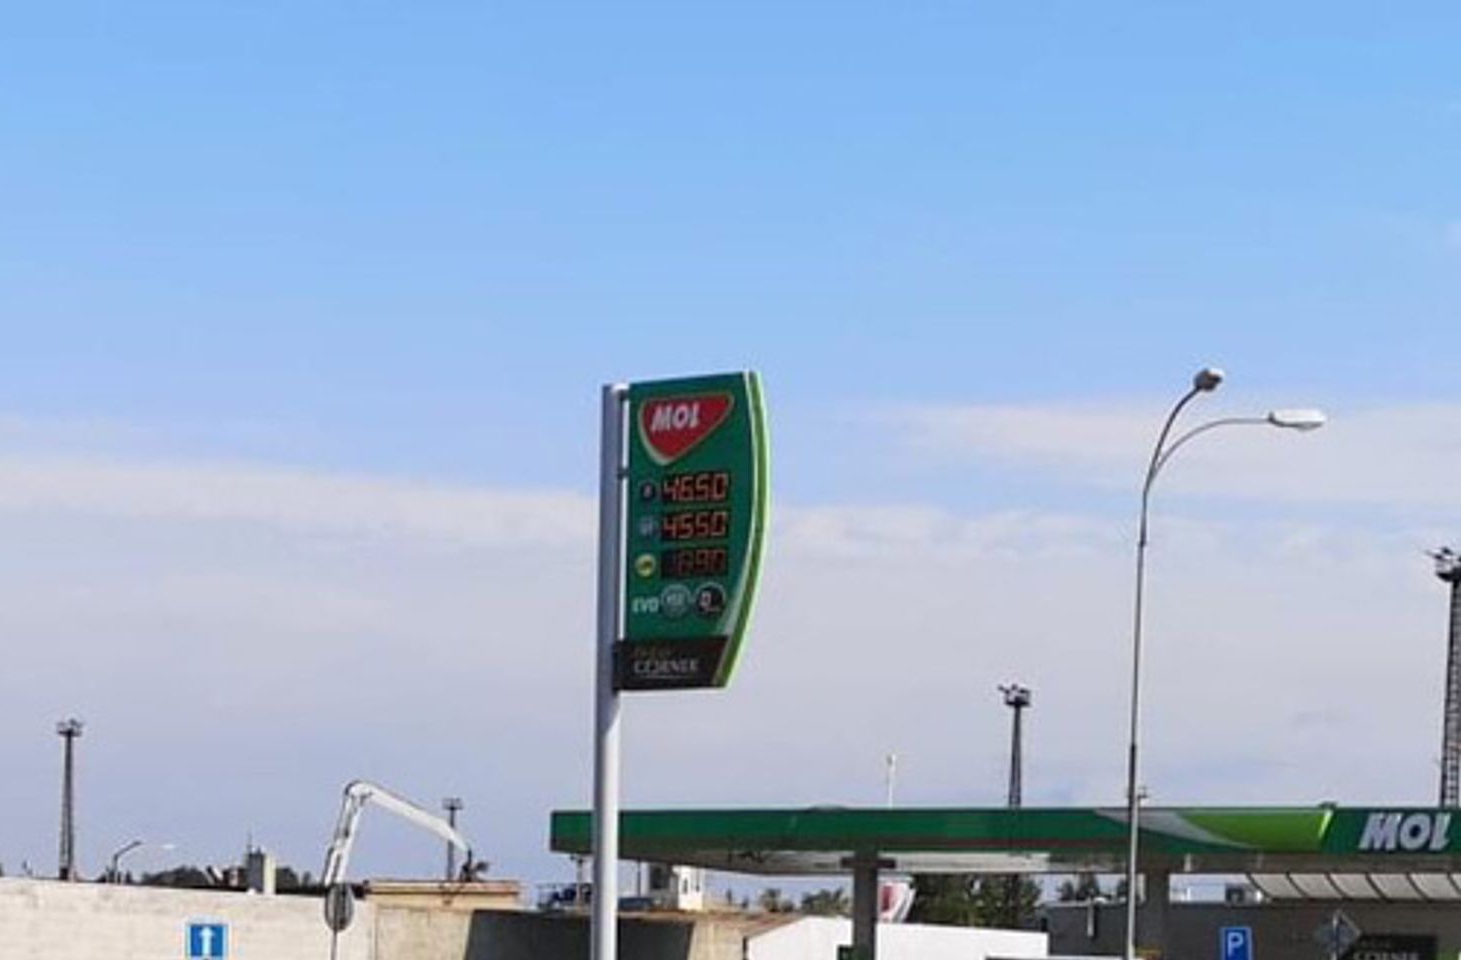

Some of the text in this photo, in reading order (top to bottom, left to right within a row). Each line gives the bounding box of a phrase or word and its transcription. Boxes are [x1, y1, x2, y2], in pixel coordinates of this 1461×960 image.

[650, 401, 701, 434] MOL
[1358, 812, 1452, 851] MOL
[1226, 931, 1244, 958] P
